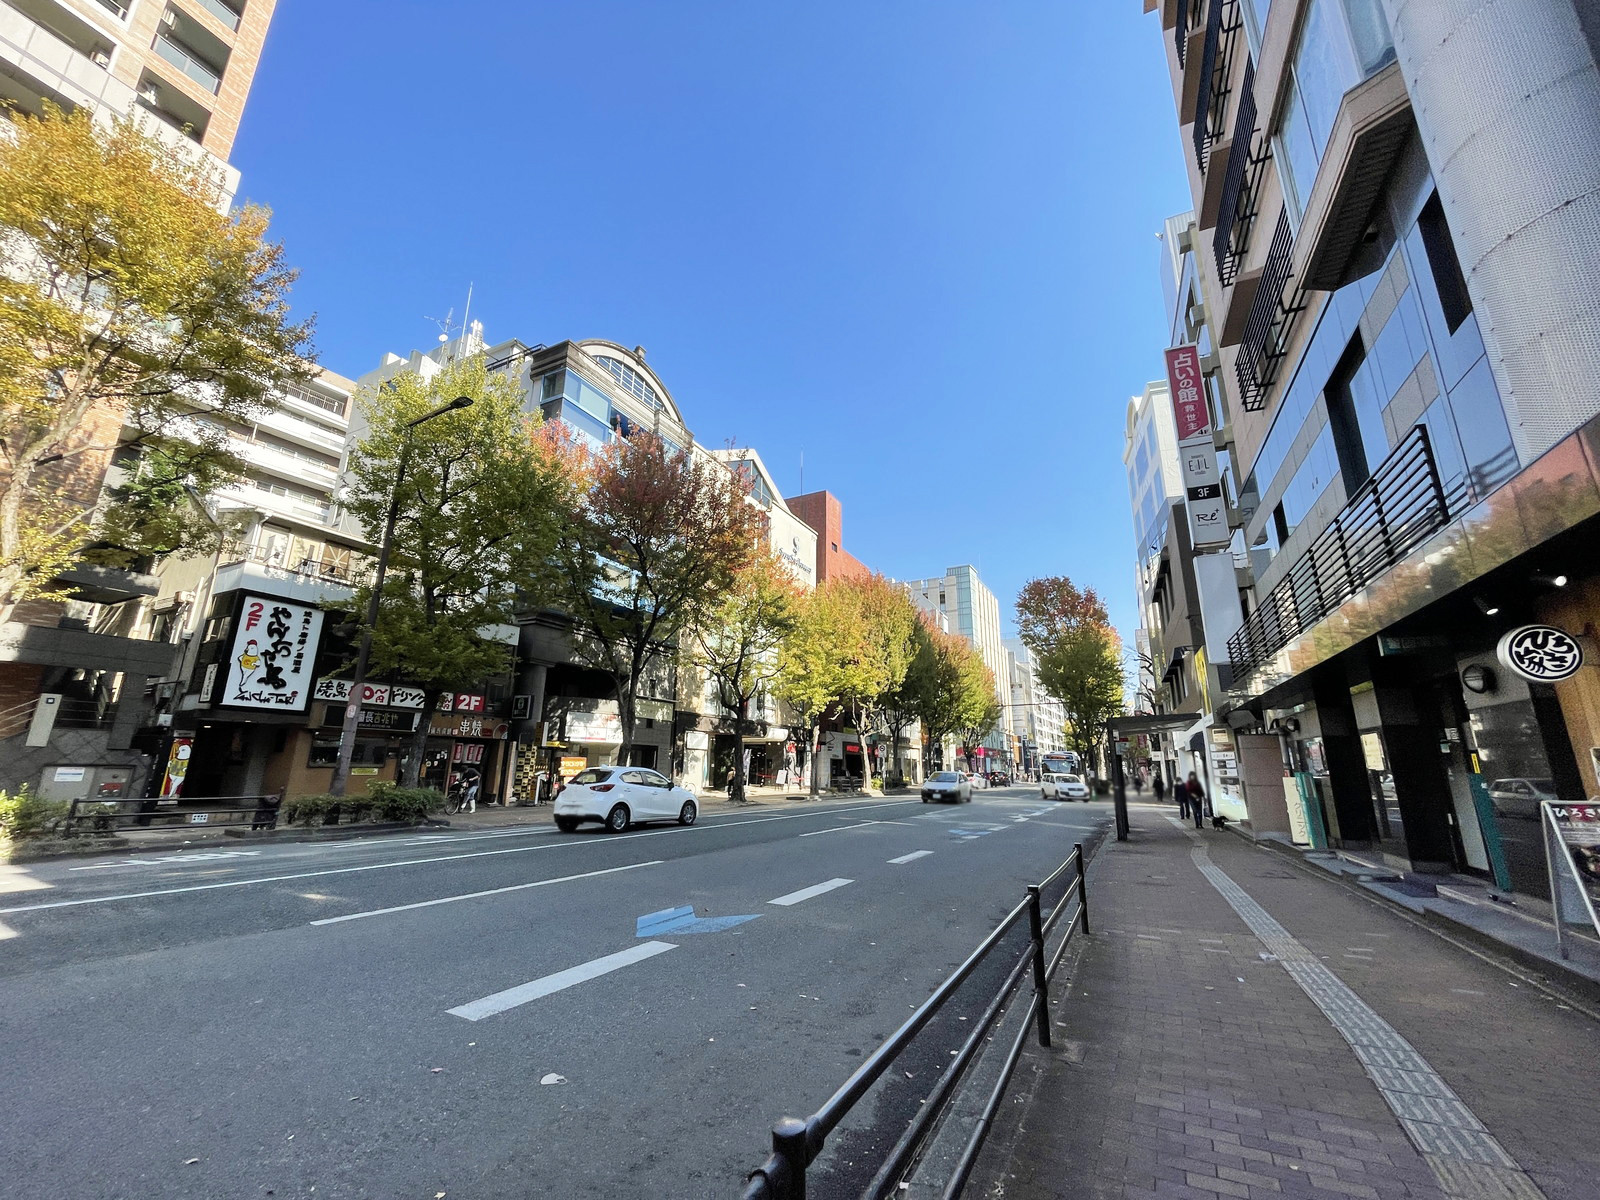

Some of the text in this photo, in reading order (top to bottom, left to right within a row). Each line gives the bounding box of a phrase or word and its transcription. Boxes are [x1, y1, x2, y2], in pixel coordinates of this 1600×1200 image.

[1174, 353, 1199, 403] 占いの館
[1197, 487, 1210, 497] 3F
[245, 602, 264, 631] 2F
[457, 695, 481, 711] 2F
[459, 719, 483, 737] 串焼
